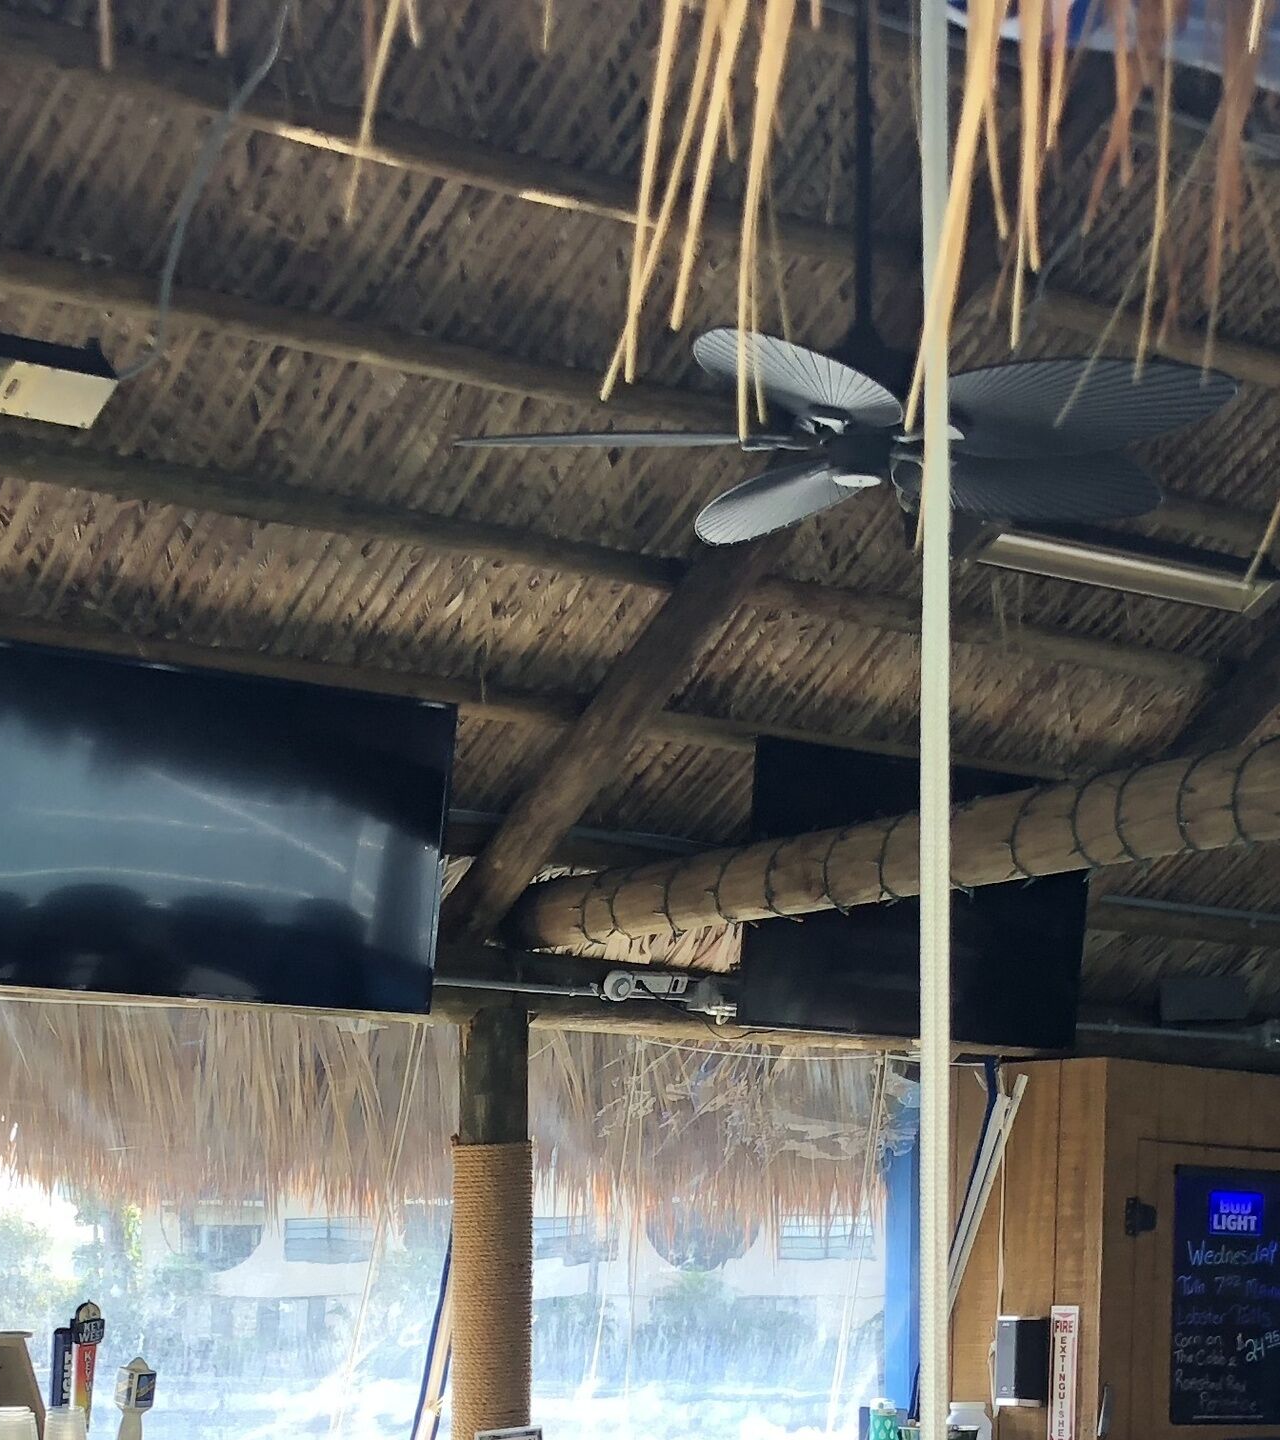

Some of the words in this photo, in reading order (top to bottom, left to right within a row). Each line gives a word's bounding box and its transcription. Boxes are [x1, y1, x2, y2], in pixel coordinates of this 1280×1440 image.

[1212, 1215, 1258, 1232] LIGHT
[1054, 1320, 1075, 1334] FIRE
[79, 1331, 104, 1344] WEST
